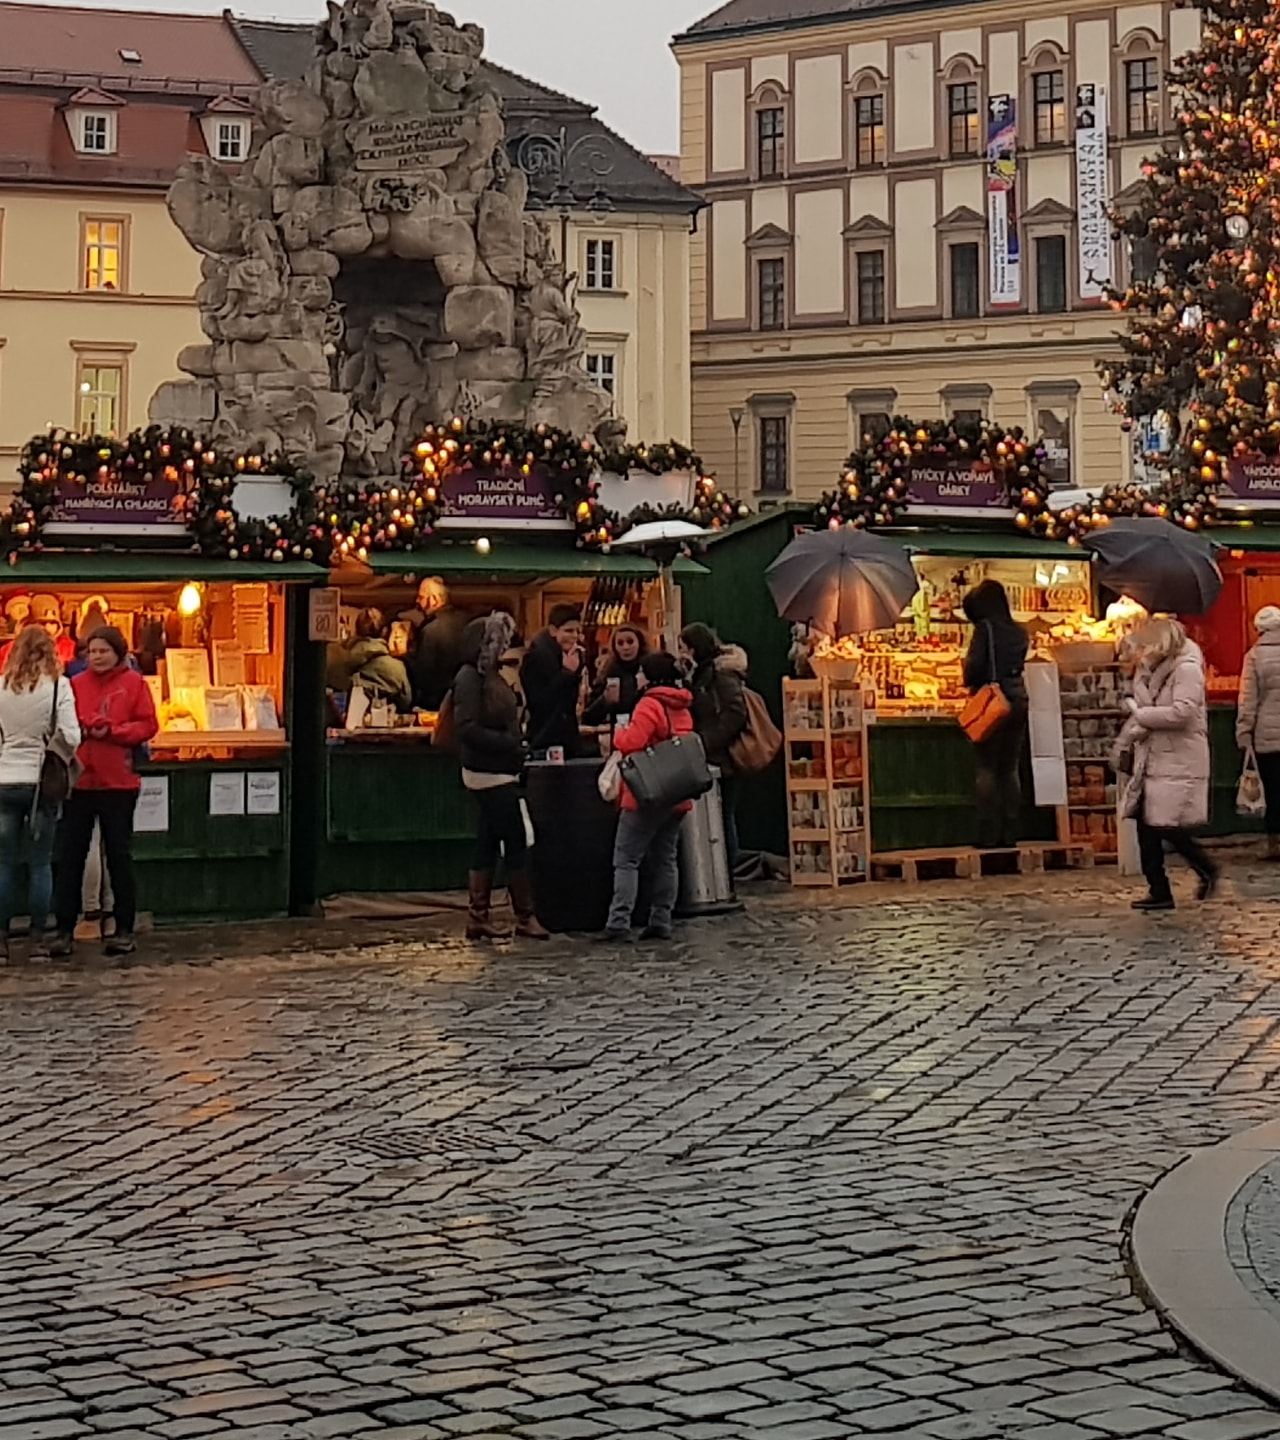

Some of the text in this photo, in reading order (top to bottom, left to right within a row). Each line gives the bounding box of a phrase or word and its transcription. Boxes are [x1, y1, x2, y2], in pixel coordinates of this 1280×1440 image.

[911, 467, 946, 481] SVÍČKY
[947, 470, 955, 481] A
[86, 481, 147, 496] POLŠTÁŘKY
[476, 478, 525, 491] TRADIČNÍ
[938, 482, 970, 496] DÁRKY
[458, 492, 545, 506] MORAVSKÝ PUNČ
